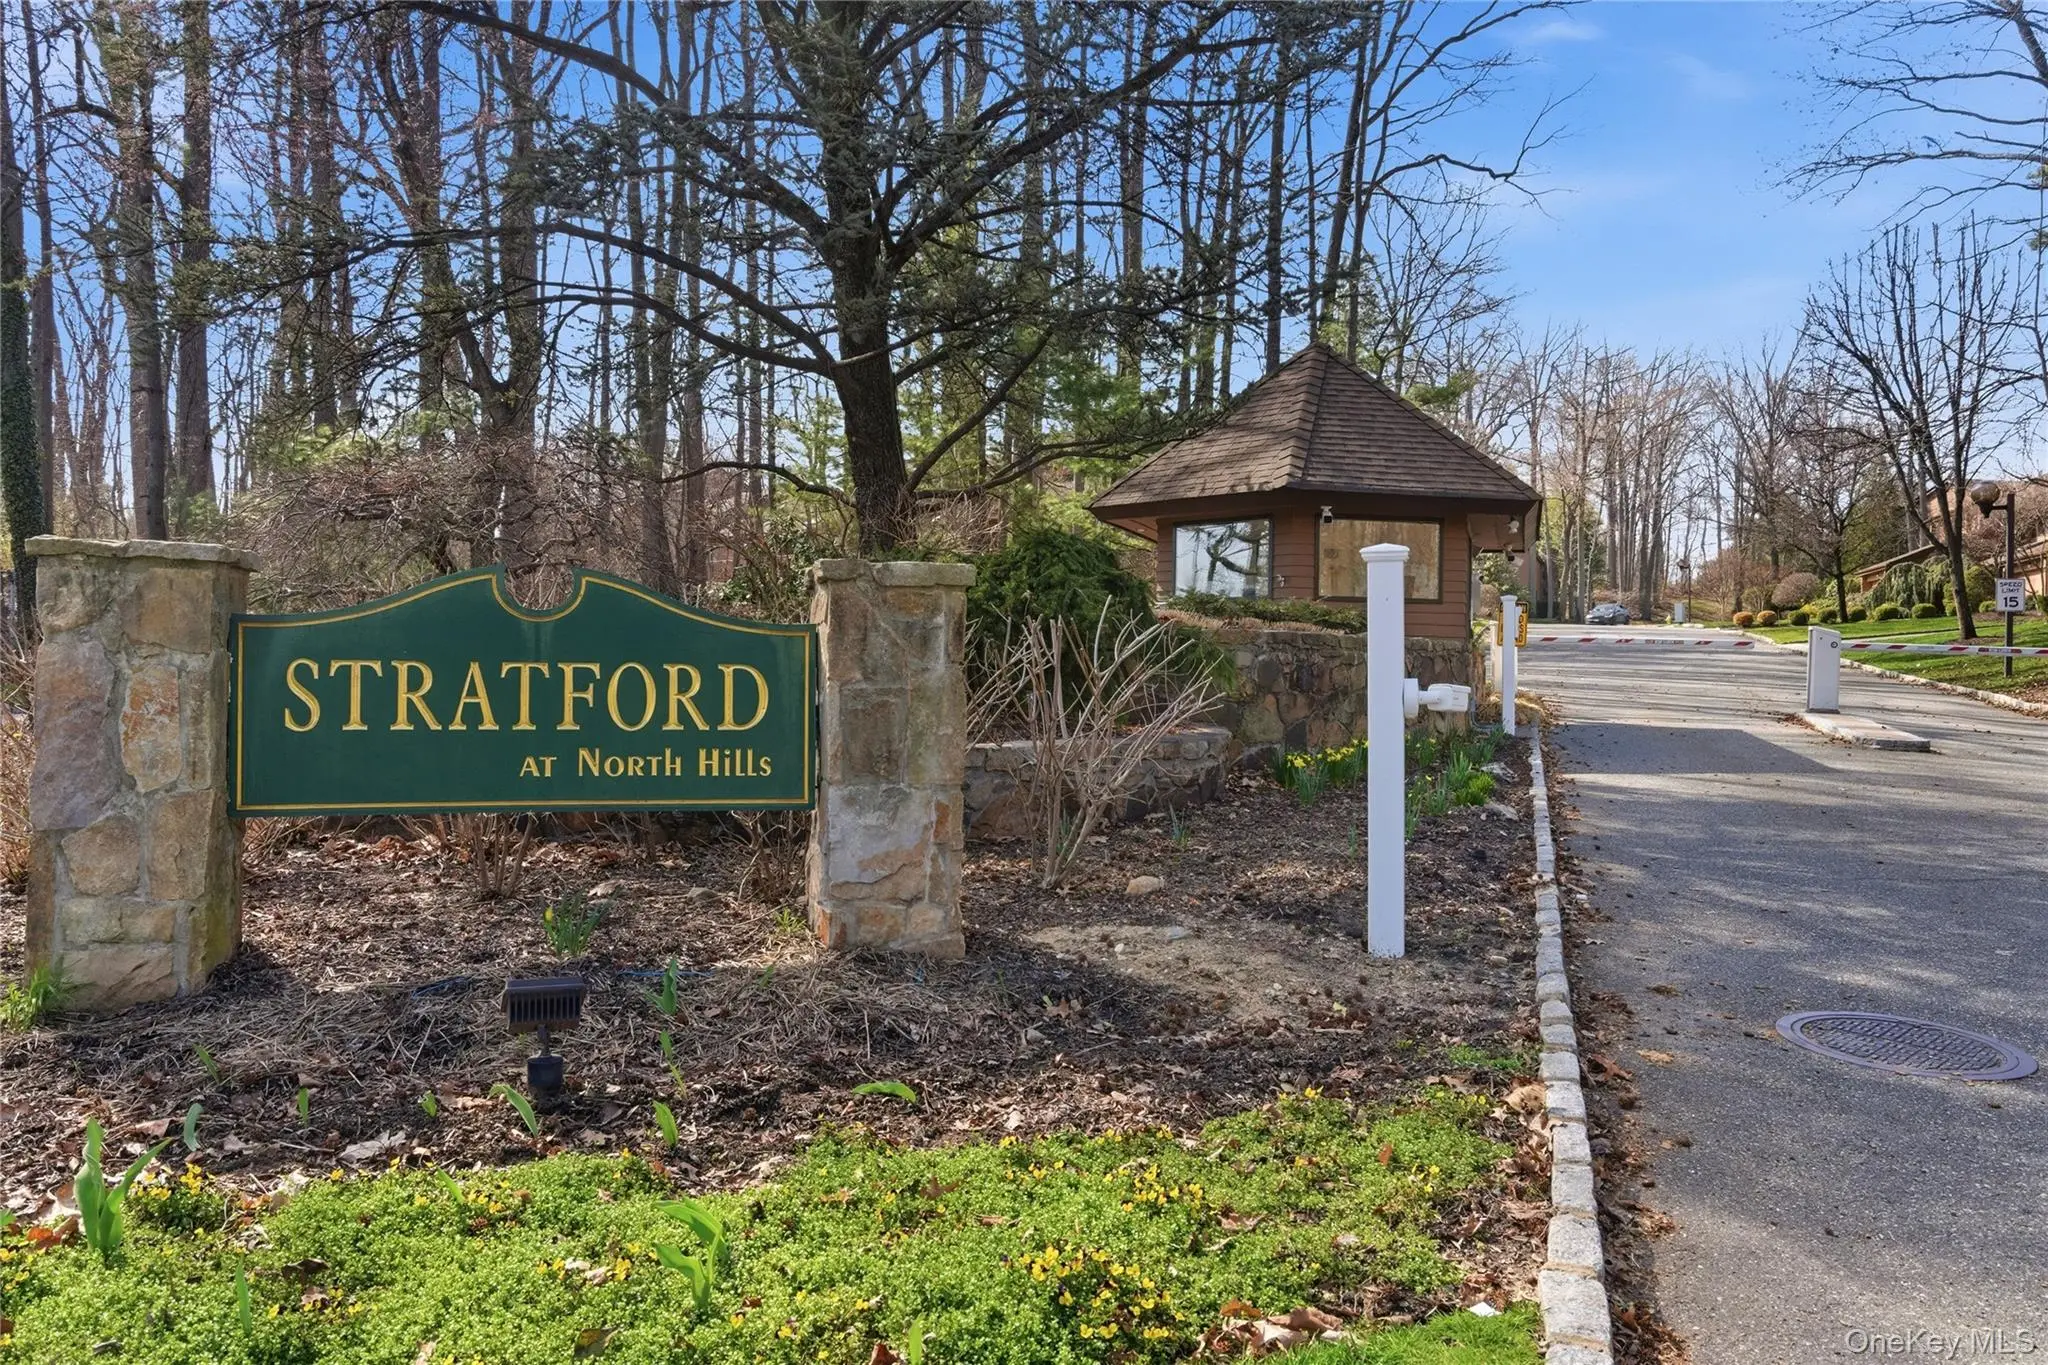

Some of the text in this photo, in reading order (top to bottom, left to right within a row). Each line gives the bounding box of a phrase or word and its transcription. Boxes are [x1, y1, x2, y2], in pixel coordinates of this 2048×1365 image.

[2003, 596, 2019, 608] 15
[284, 658, 770, 733] STRATFORD
[519, 755, 558, 778] AT
